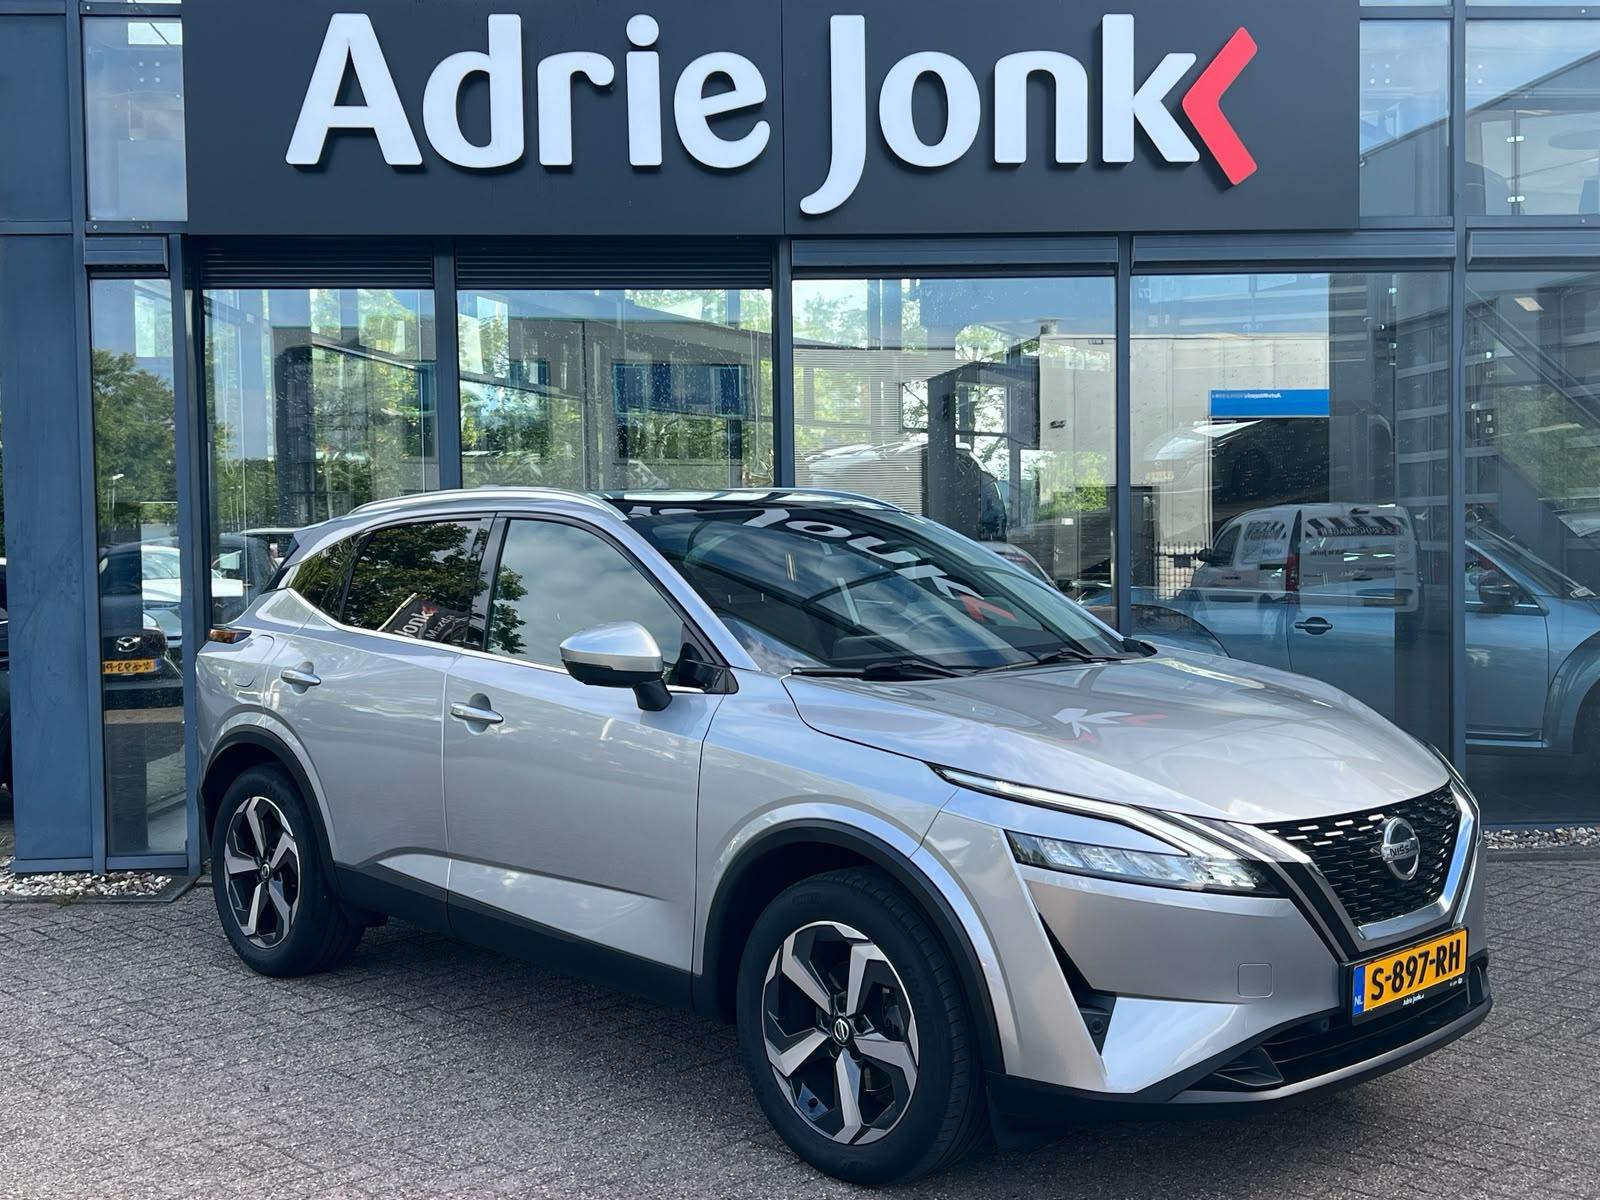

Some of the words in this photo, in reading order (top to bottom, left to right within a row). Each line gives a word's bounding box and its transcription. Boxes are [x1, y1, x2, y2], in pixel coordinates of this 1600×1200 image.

[285, 13, 770, 168] Adrie
[800, 14, 1200, 215] Jonk
[425, 614, 455, 640] Mazda
[1370, 938, 1461, 1001] S-897-RH
[1354, 996, 1363, 1007] NL
